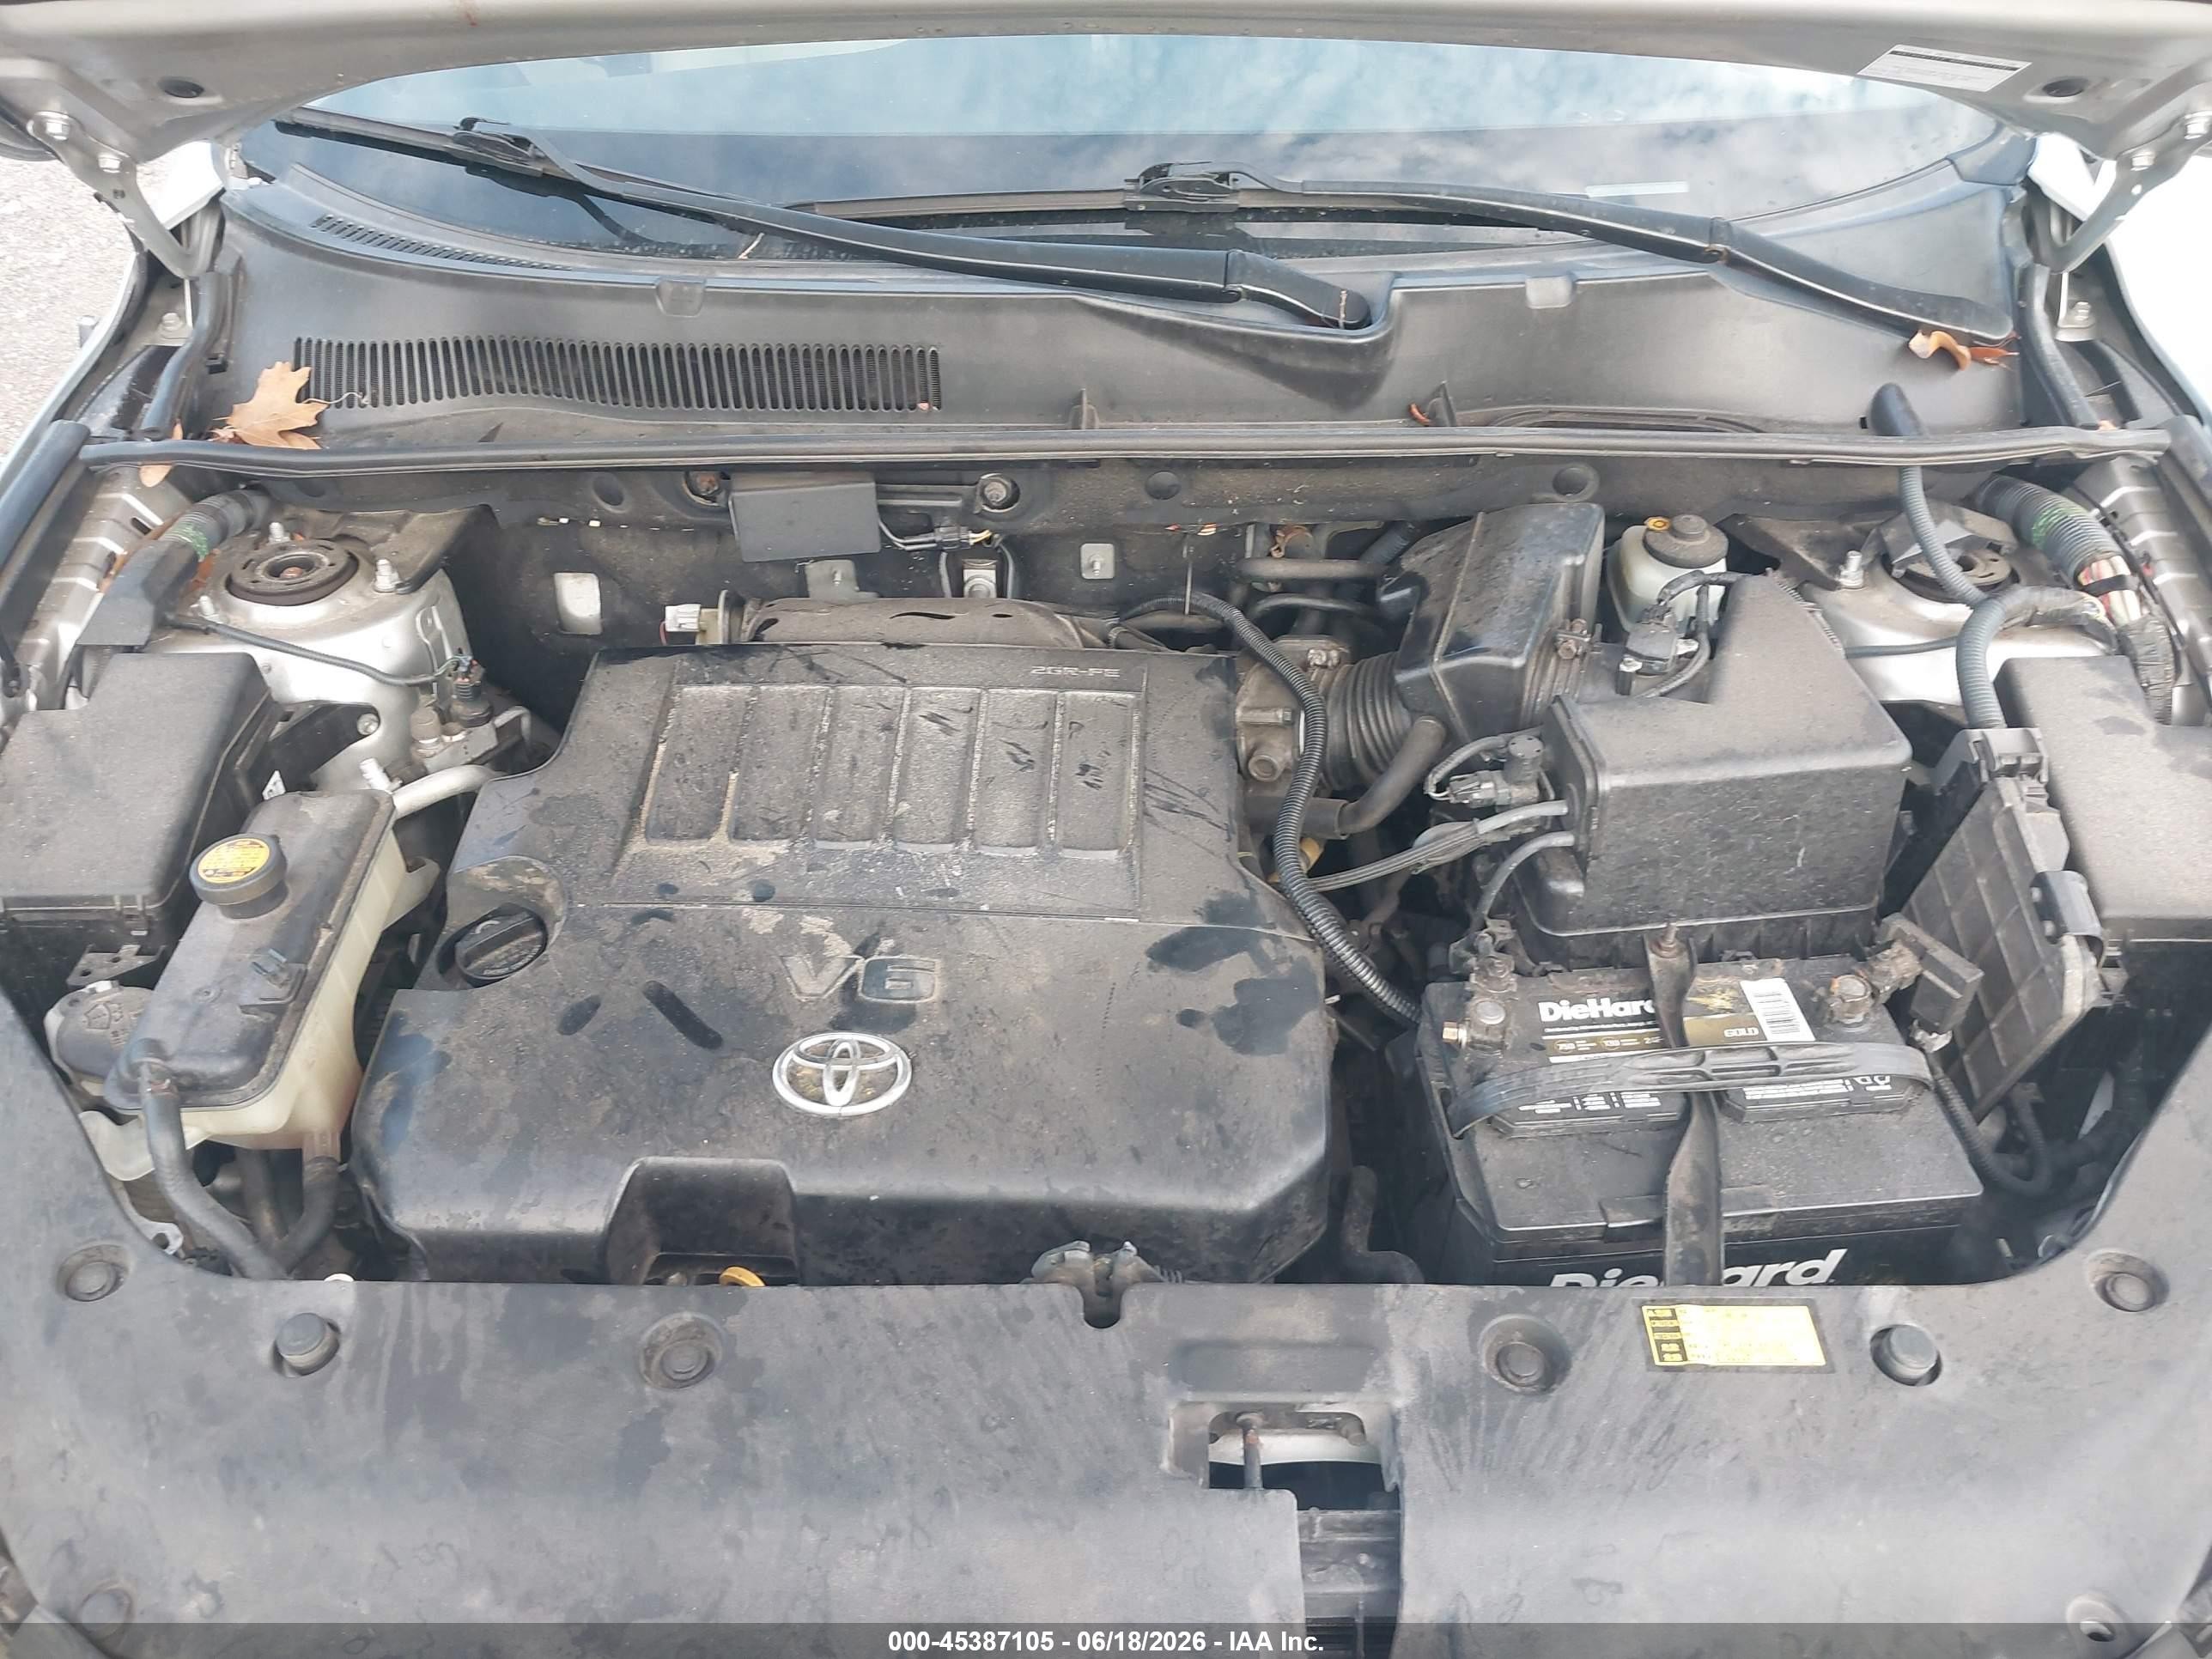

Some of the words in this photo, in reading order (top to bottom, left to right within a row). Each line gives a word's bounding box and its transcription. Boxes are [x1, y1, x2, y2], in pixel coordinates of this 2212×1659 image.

[1031, 665, 1121, 678] 2GR-FE
[778, 955, 939, 1004] V6
[1723, 1027, 1759, 1037] GOLD
